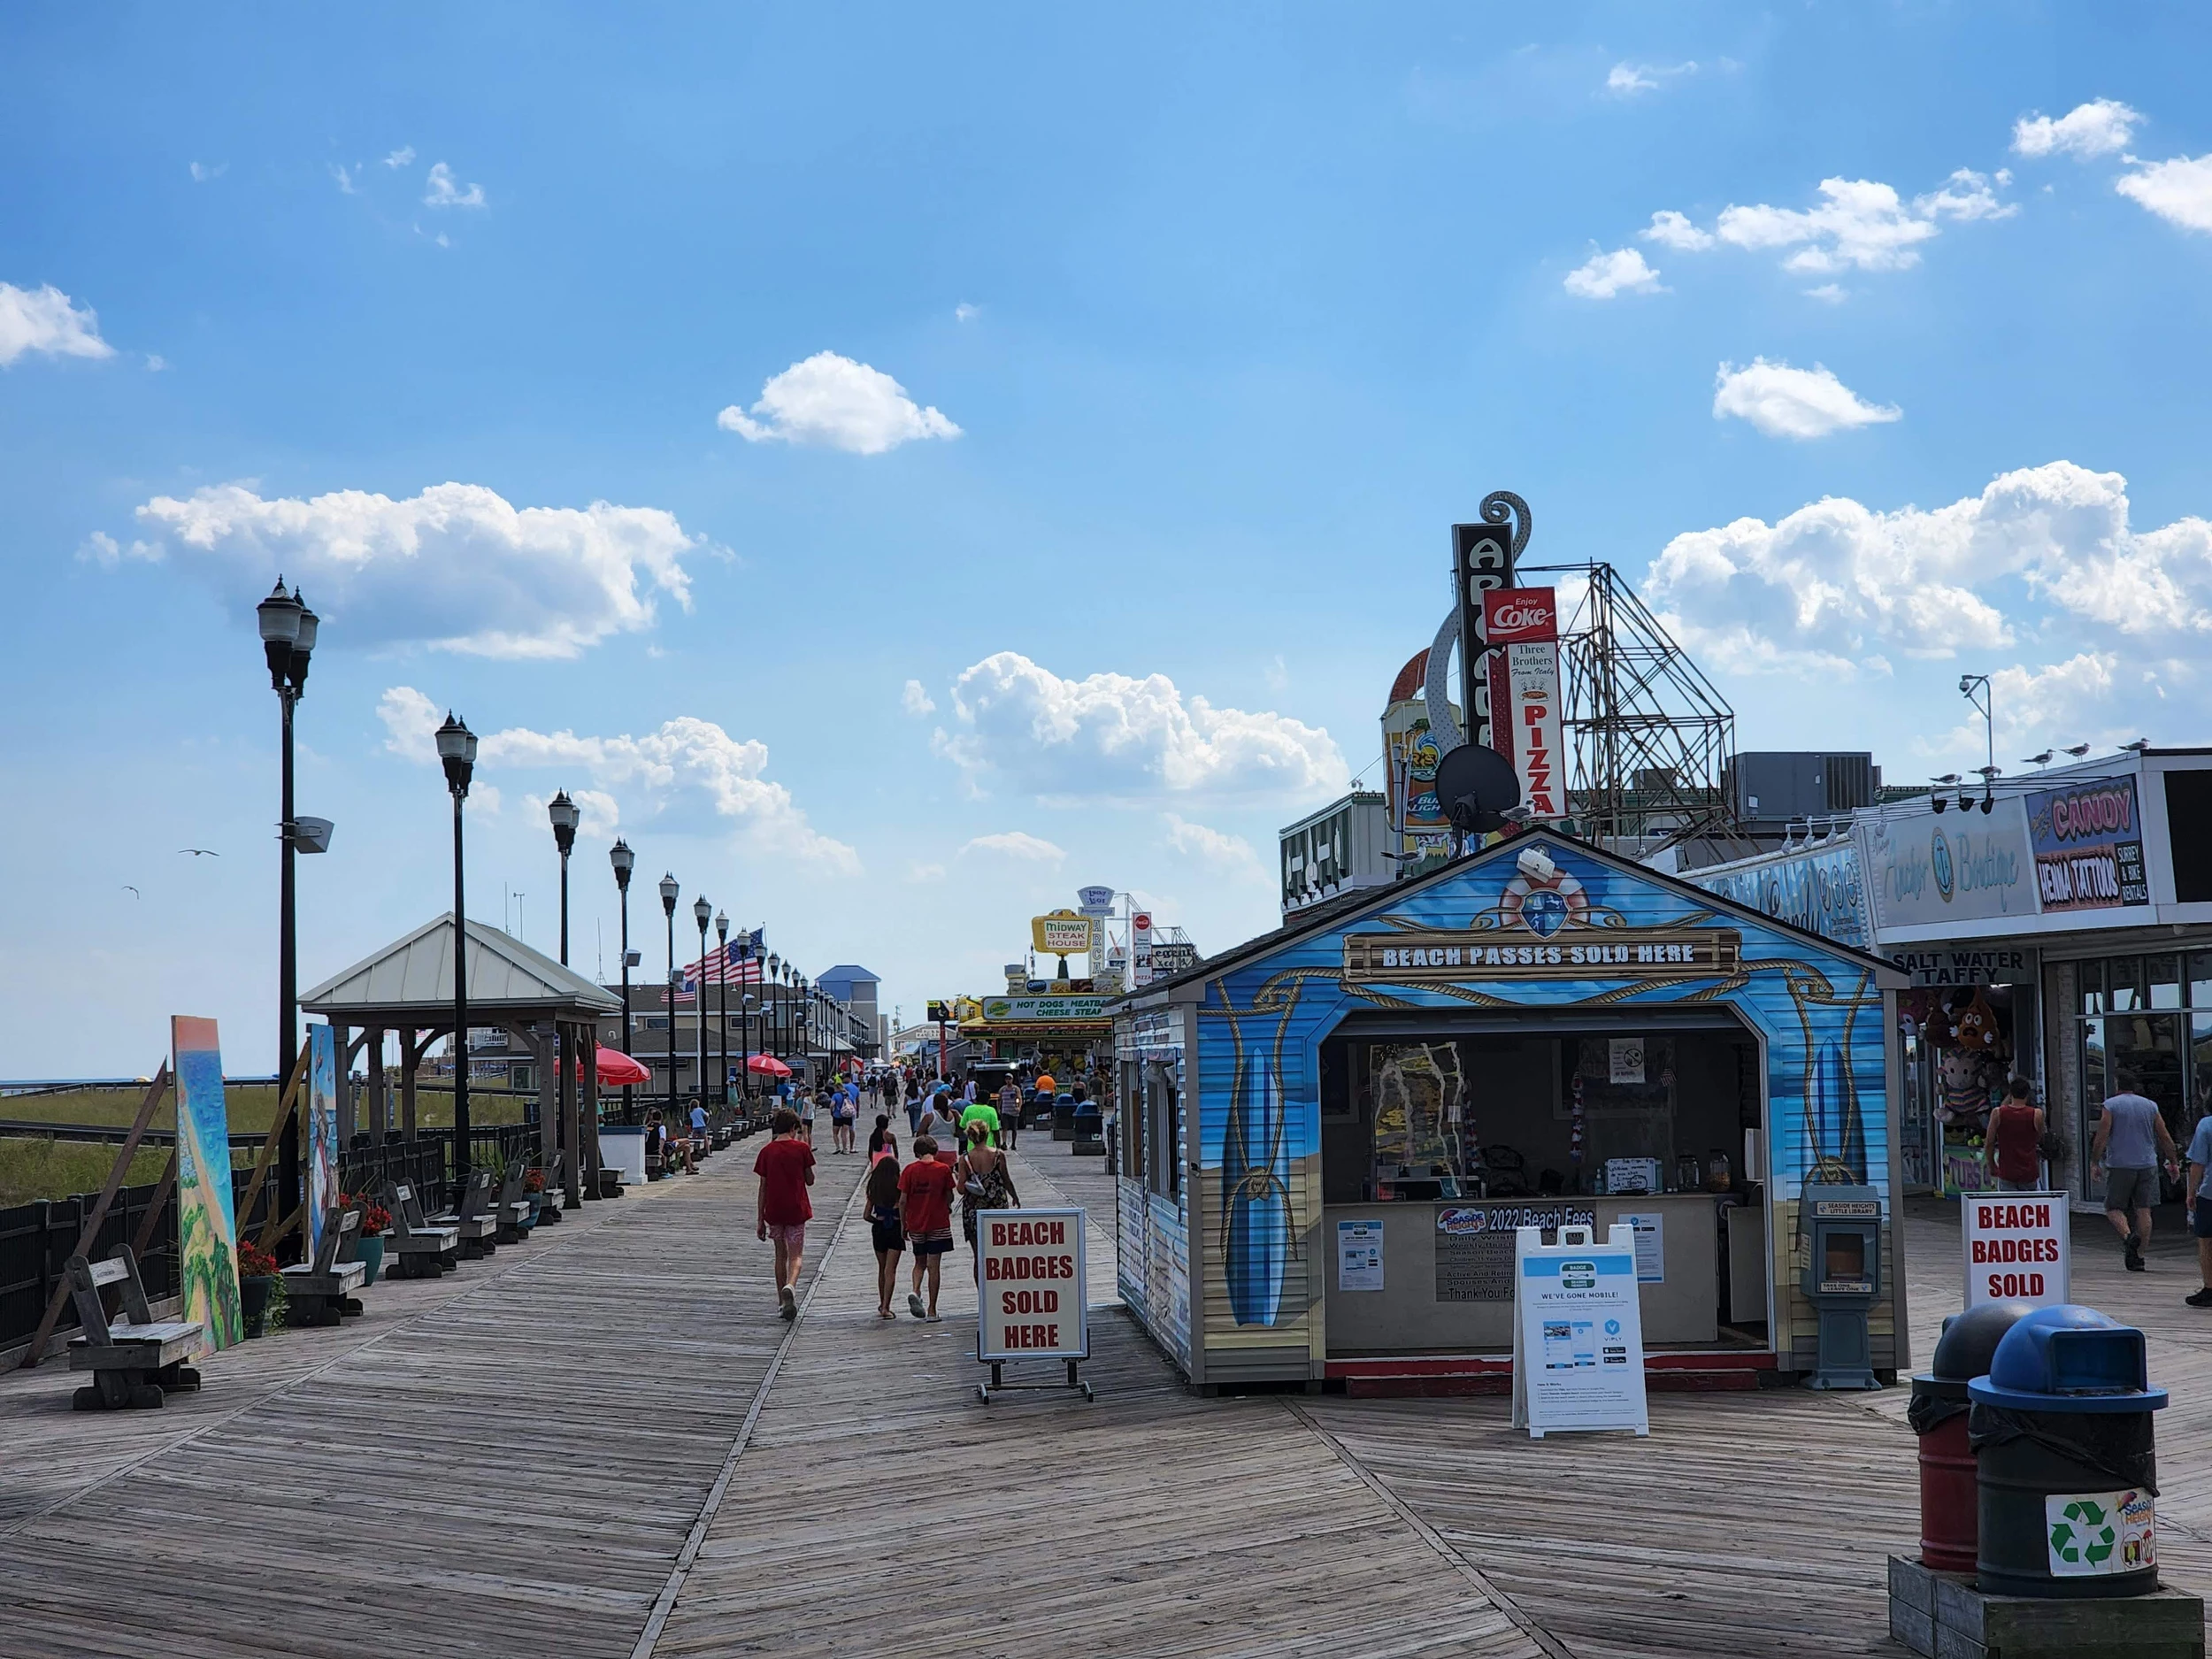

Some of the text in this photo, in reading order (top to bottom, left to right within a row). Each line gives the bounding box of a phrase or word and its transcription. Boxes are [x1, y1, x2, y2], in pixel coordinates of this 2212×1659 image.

[1515, 597, 1539, 607] Enjoy
[1494, 604, 1555, 628] Coke
[1512, 656, 1553, 666] Brothers
[1517, 644, 1546, 655] Three
[1511, 666, 1555, 678] From Italy
[1524, 705, 1556, 814] PIZZA
[2052, 787, 2131, 838] CANDY
[2117, 844, 2139, 863] SURREY
[2038, 855, 2119, 903] HENNA TATTOOS
[2123, 864, 2142, 882] & BIKE
[2122, 883, 2147, 902] RENTALS
[1383, 942, 1694, 968] BEACH PASSES SOLD HERE
[1893, 951, 2024, 971] SALT WATER
[1918, 967, 1999, 985] TAFFY
[1070, 999, 1106, 1008] MEATB
[1948, 1156, 1981, 1190] TUBS
[1489, 1207, 1594, 1231] 2022 Beach Fees
[1978, 1204, 2050, 1229] BEACH
[991, 1221, 1064, 1247] BEACH
[1971, 1238, 2059, 1264] BADGES
[986, 1255, 1073, 1281] BADGES
[1448, 1287, 1478, 1300] Thank
[1481, 1286, 1501, 1300] You
[1988, 1272, 2045, 1298] SOLD
[1002, 1290, 1059, 1315] SOLD
[1004, 1324, 1060, 1349] HERE
